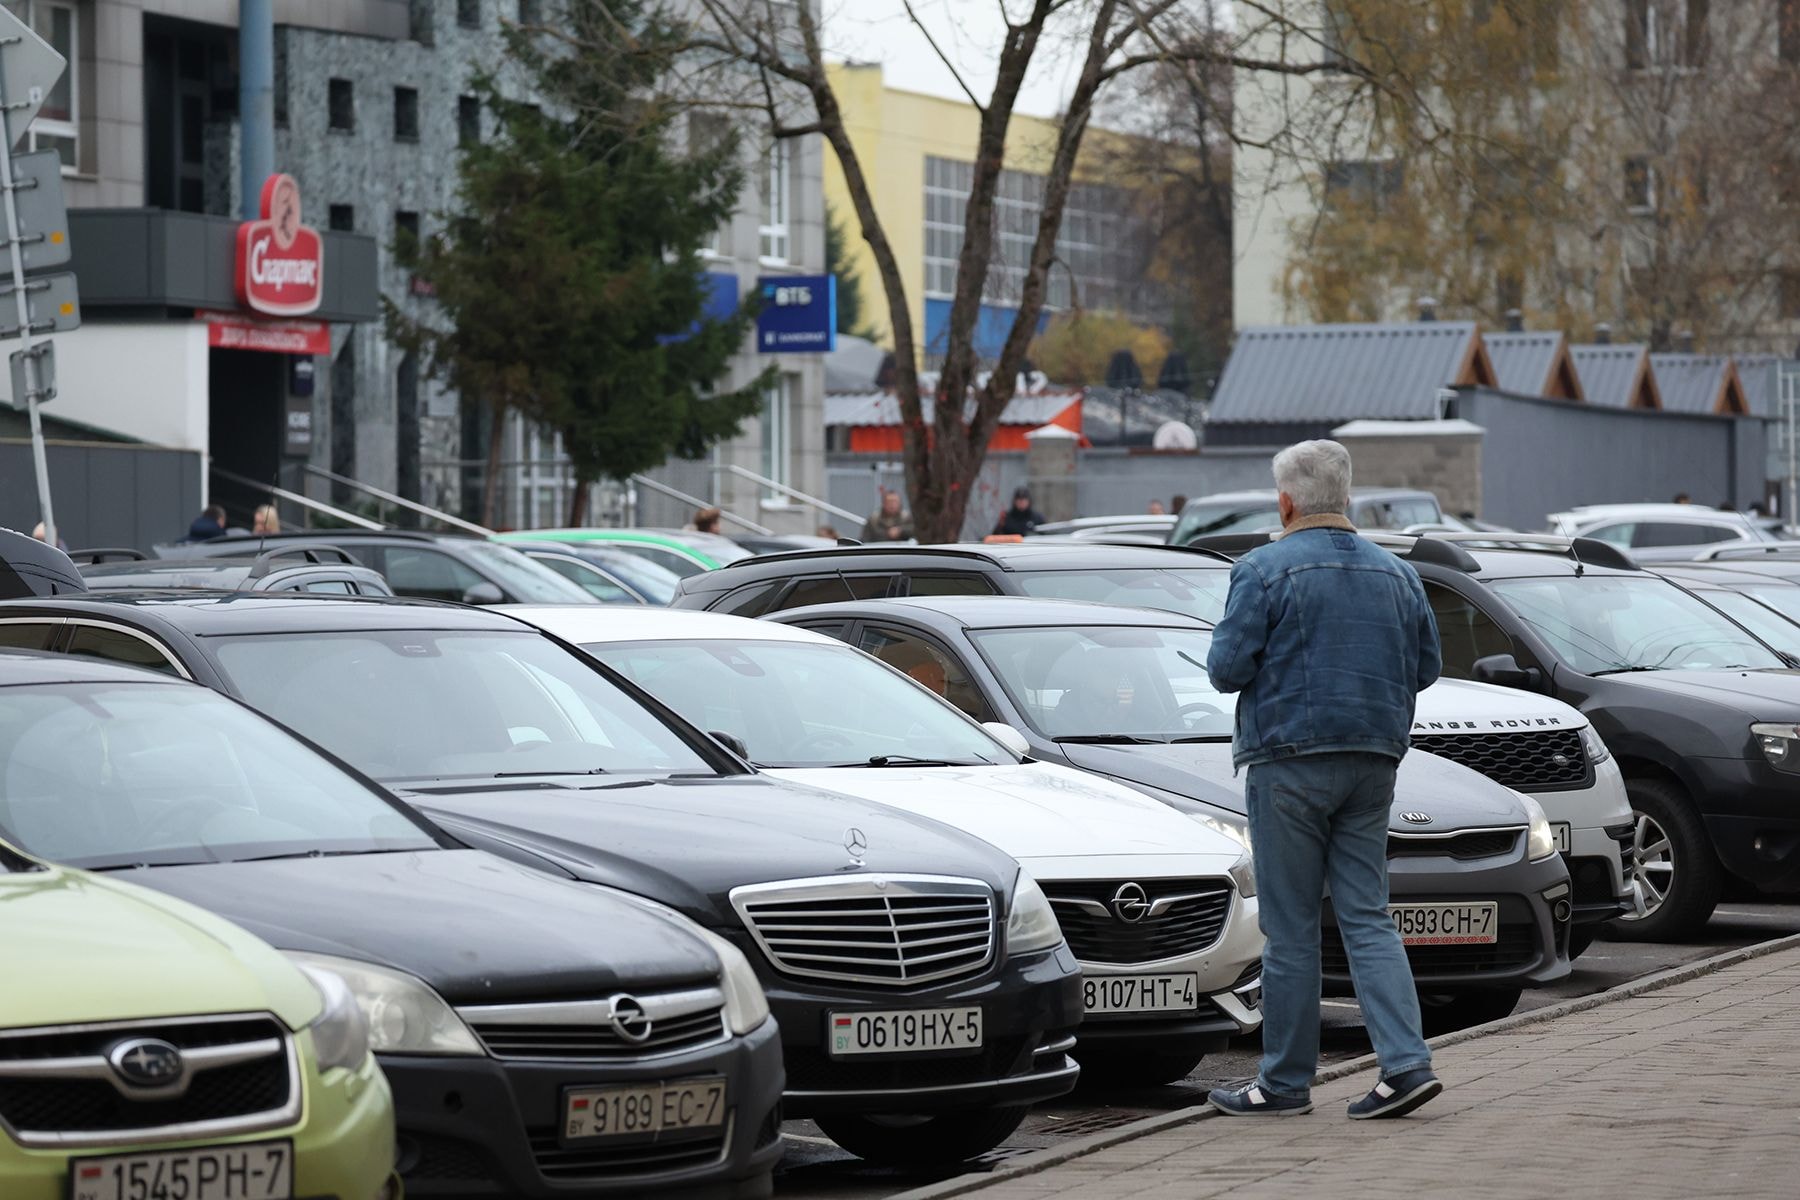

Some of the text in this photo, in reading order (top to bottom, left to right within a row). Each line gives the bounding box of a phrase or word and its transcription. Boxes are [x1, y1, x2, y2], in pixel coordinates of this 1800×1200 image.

[252, 235, 316, 291] Спартак
[775, 286, 812, 306] ВТБ
[1413, 717, 1561, 730] ANGE ROVER
[836, 1036, 850, 1050] BY
[569, 1120, 585, 1135] BY
